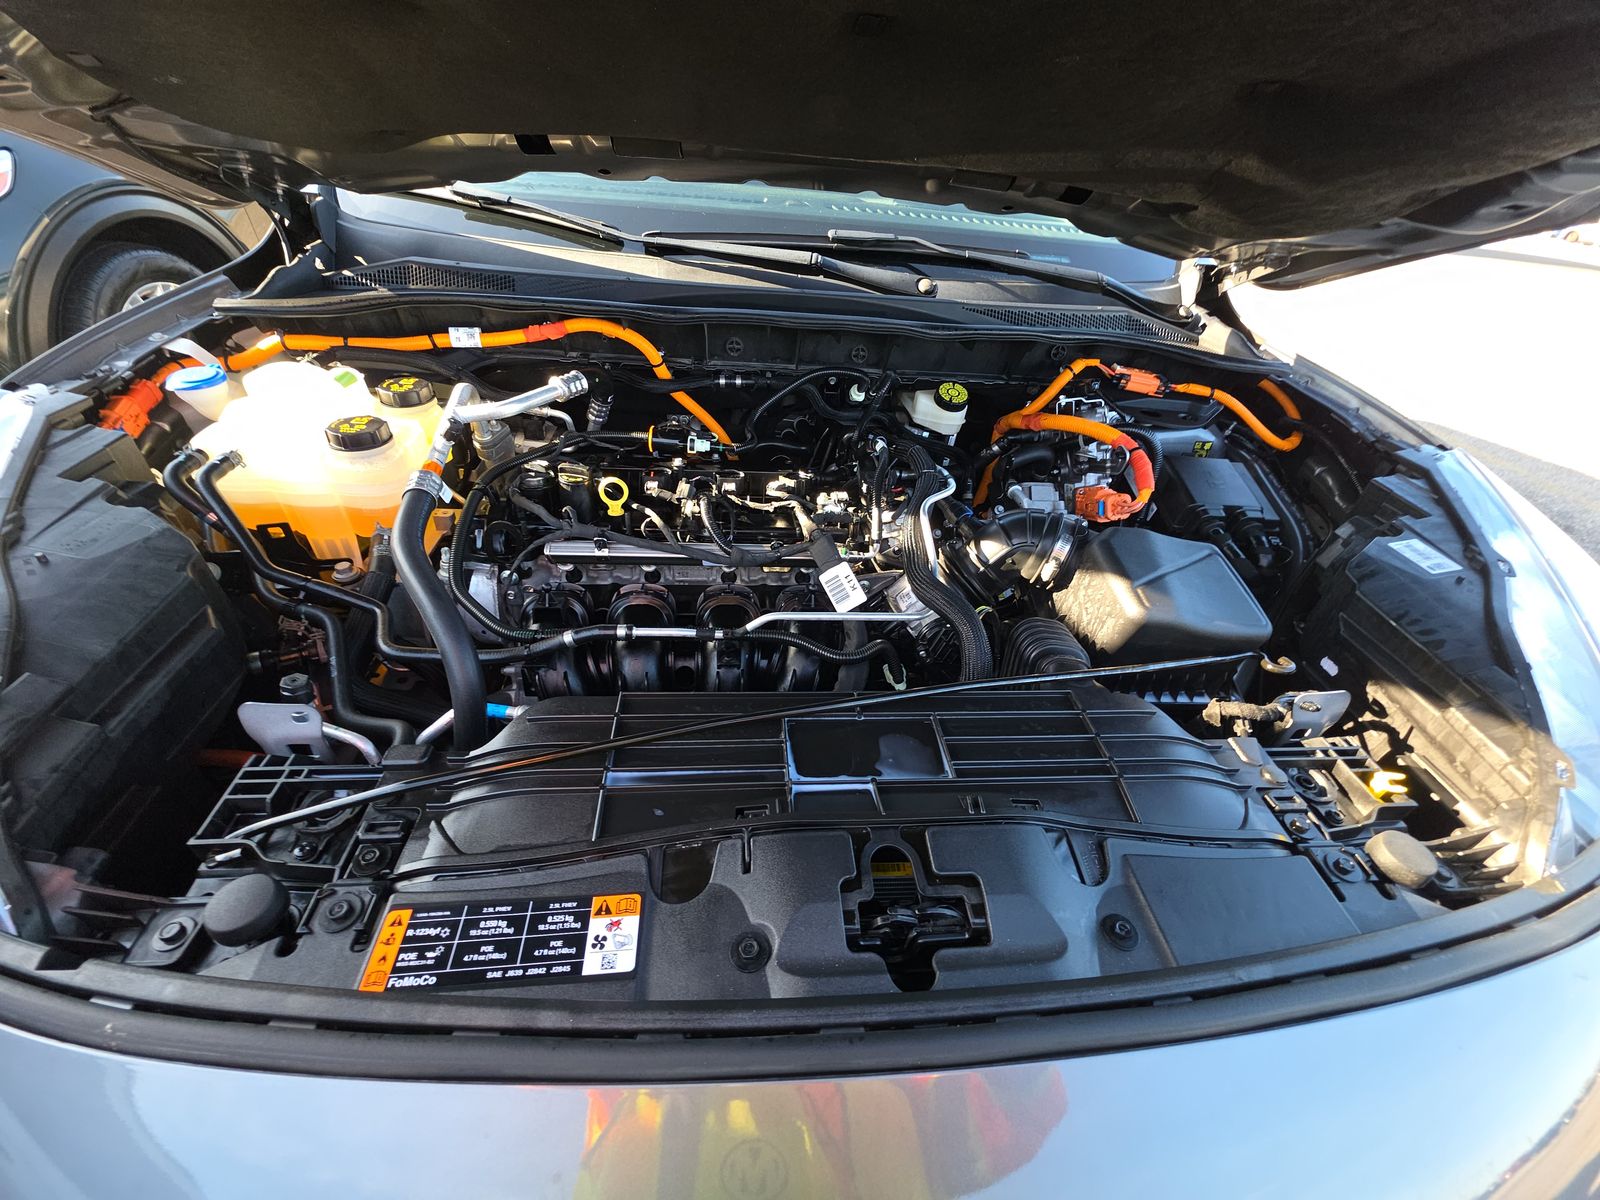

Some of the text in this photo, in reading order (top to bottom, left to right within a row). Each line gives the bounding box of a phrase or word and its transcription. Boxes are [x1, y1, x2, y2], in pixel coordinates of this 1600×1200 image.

[565, 914, 574, 923] kg
[498, 919, 507, 928] kg
[405, 926, 442, 937] R-1234yf
[549, 940, 563, 948] POE
[480, 945, 495, 953] POE
[397, 952, 419, 961] POE
[486, 970, 504, 979] SAE
[386, 974, 438, 988] FoMoCo
